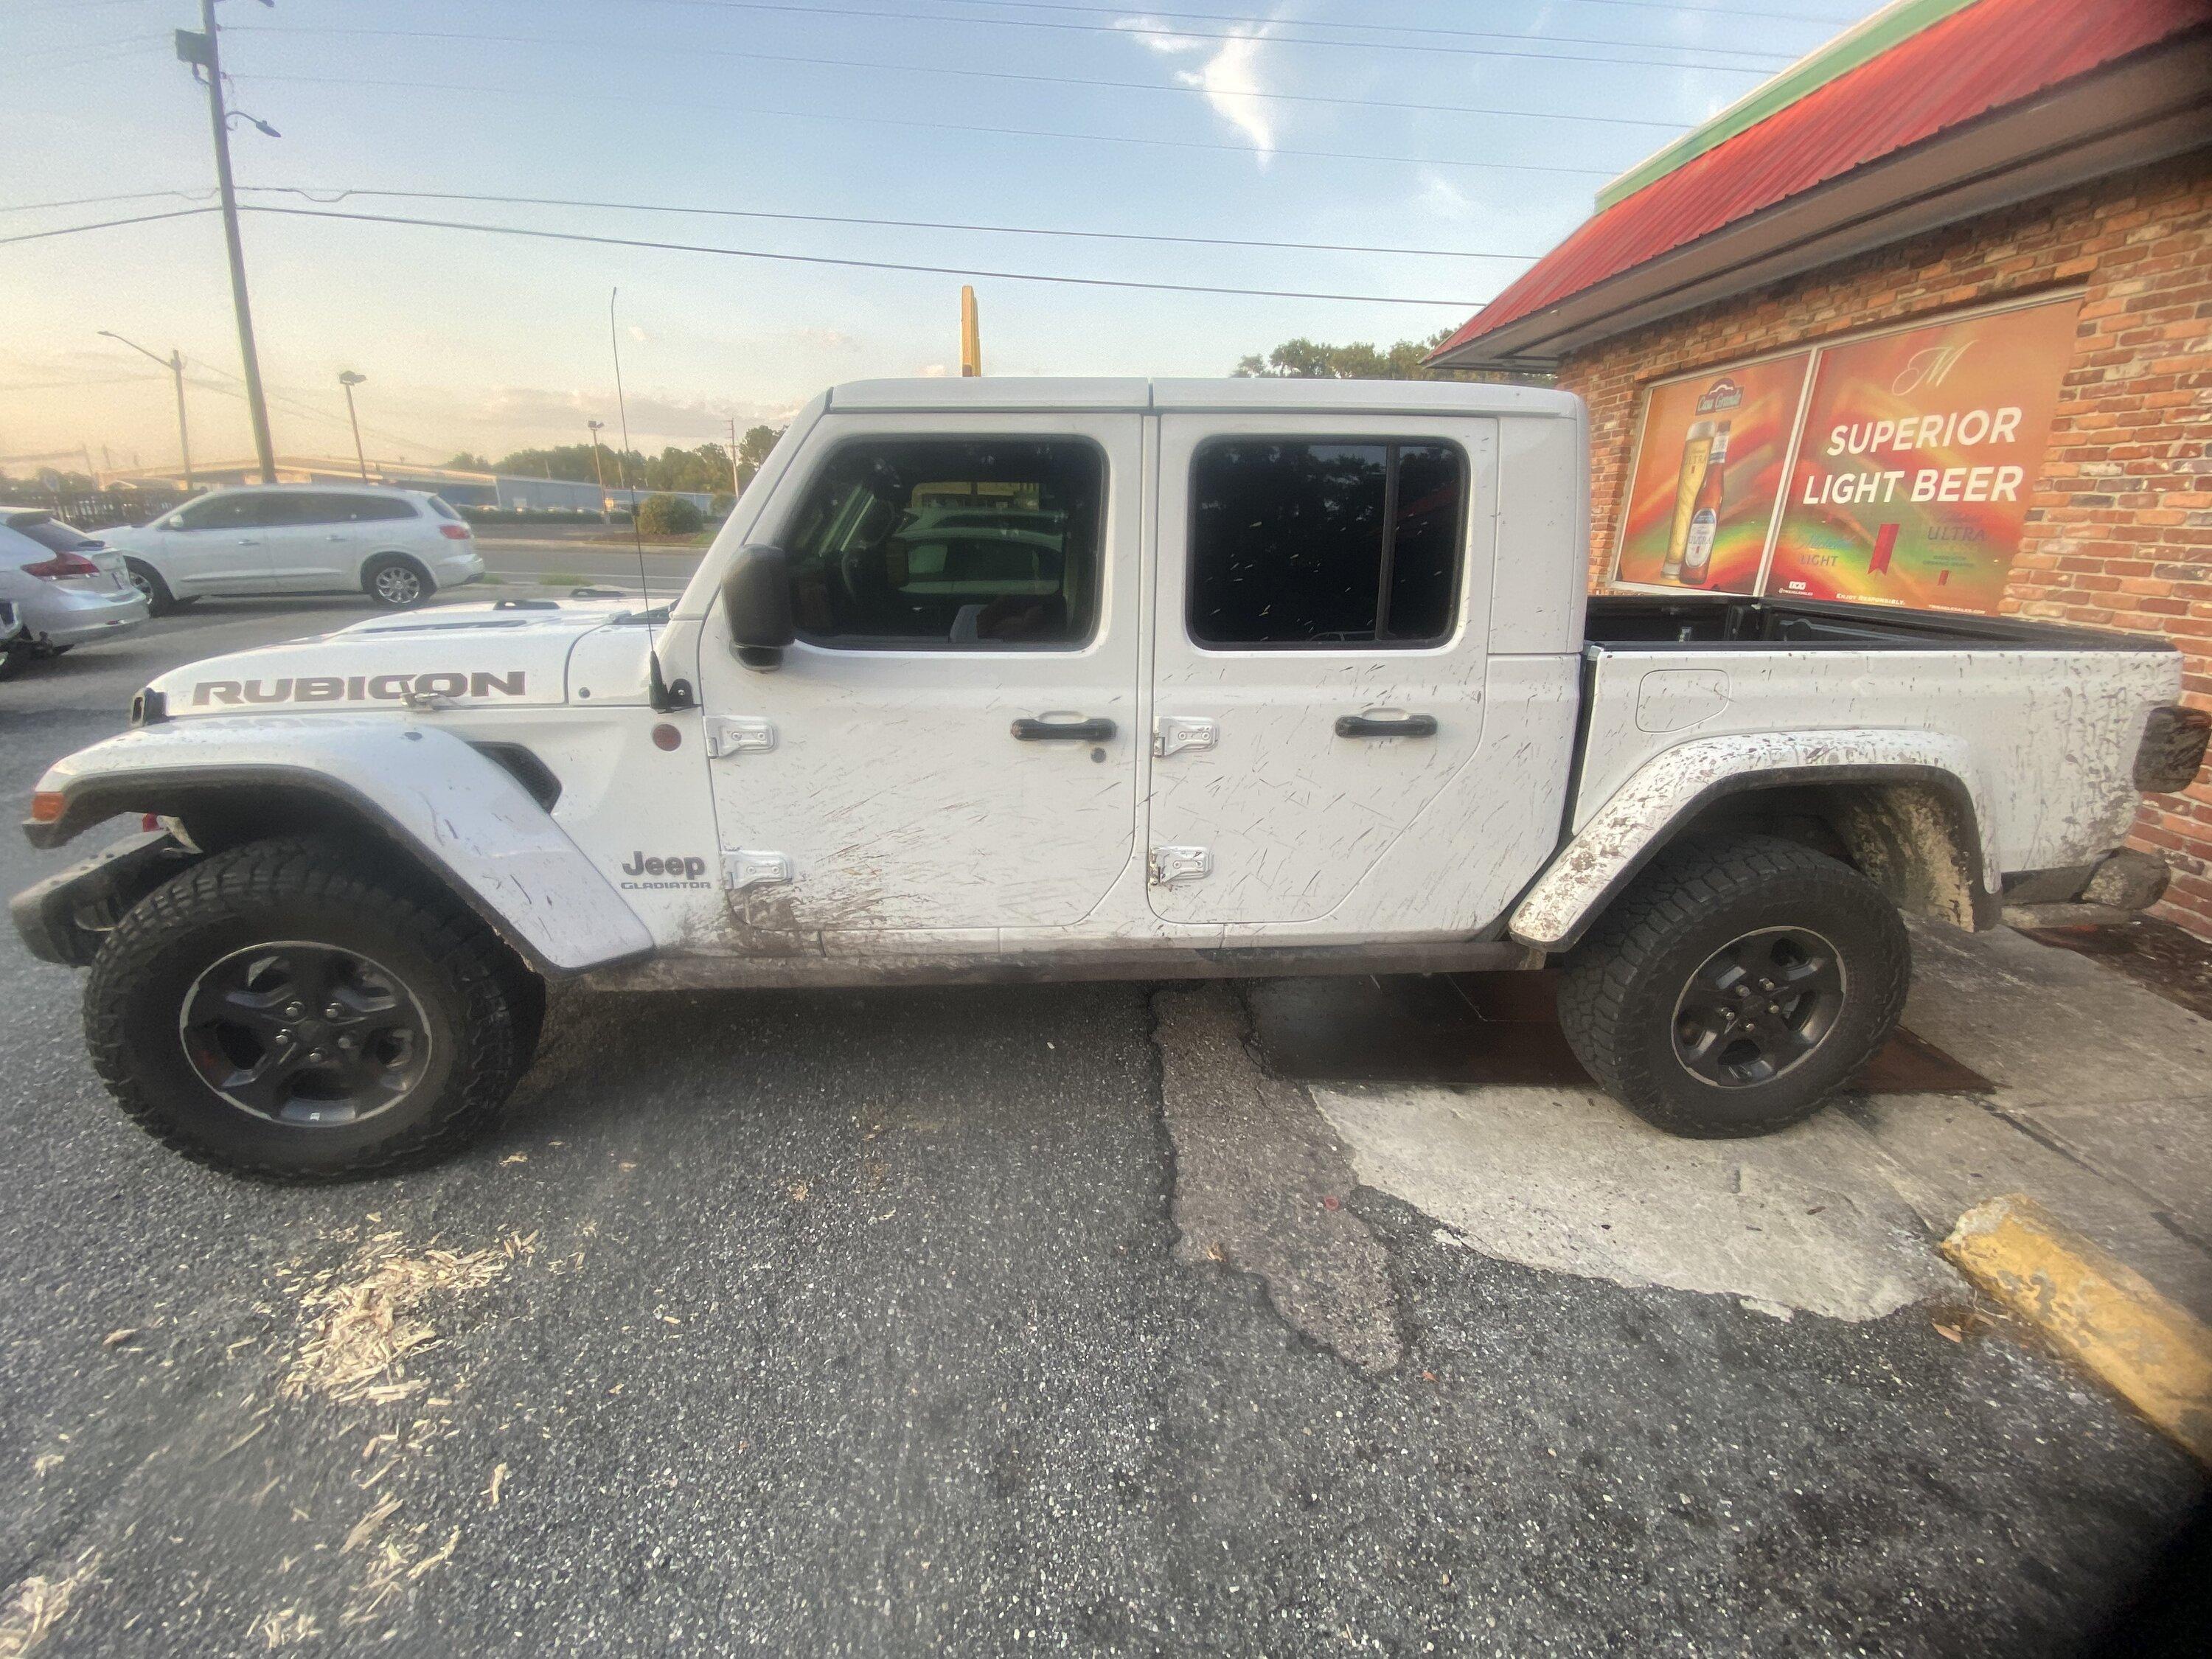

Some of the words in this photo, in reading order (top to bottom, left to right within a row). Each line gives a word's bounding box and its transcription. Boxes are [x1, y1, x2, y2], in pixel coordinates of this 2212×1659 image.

[1826, 406, 2023, 456] SUPERIOR
[1803, 470, 1905, 504] LIGHT
[1910, 465, 2024, 502] BEER
[1927, 526, 1986, 541] ULTRA
[1801, 554, 1839, 567] LIGHT
[192, 672, 526, 706] RUBICON
[622, 850, 706, 880] Jeep
[621, 882, 712, 890] GLADIATOR
